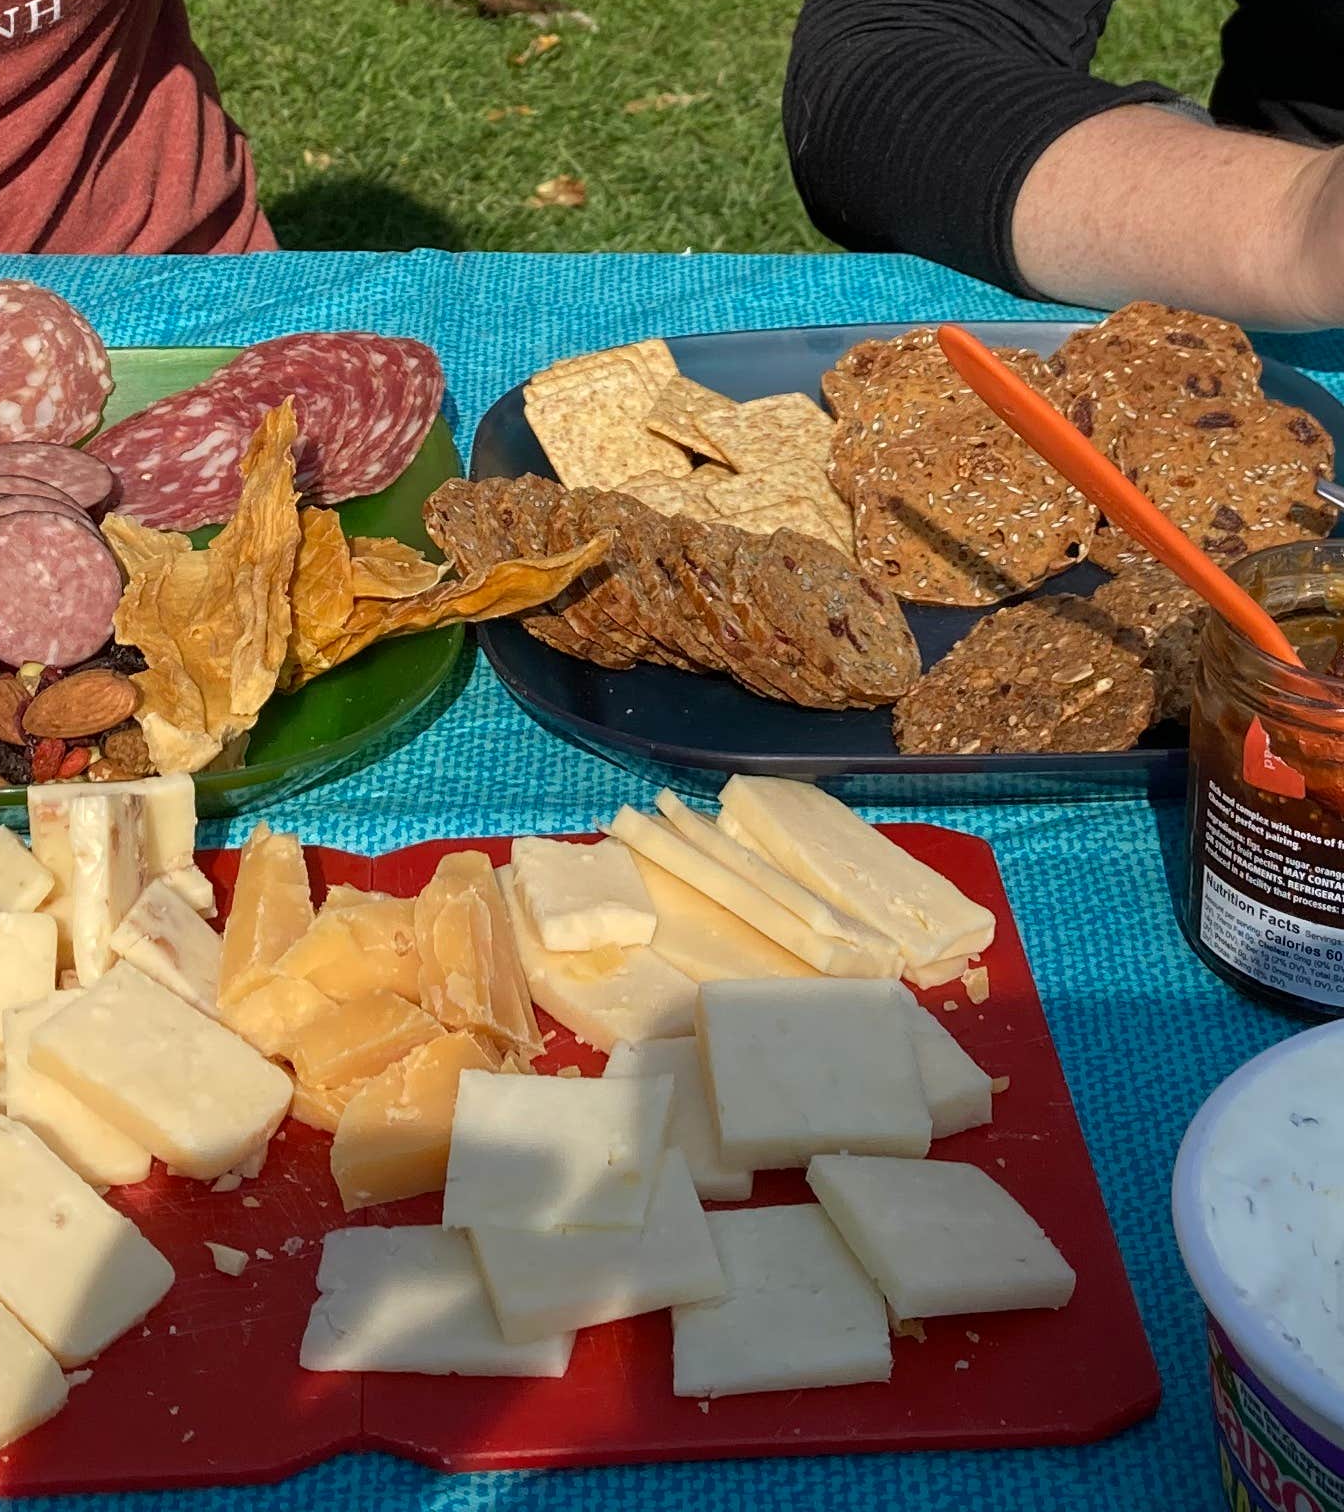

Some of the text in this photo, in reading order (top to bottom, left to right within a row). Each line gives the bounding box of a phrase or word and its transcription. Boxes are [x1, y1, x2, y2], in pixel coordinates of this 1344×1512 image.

[1235, 813, 1302, 851] perfect pairing.
[1236, 803, 1271, 828] complex
[1271, 819, 1293, 835] with
[1293, 829, 1323, 845] notes
[1324, 837, 1337, 848] of
[1215, 839, 1233, 861] STEM
[1233, 852, 1286, 887] FRAGMENTS.
[1264, 848, 1285, 862] cane
[1285, 856, 1312, 873] sugar,
[1282, 865, 1306, 881] MAY
[1246, 871, 1272, 894] facility
[1274, 886, 1292, 900] that
[1206, 871, 1256, 917] Nutrition
[1259, 907, 1301, 935] Facts
[1264, 929, 1322, 959] Calories
